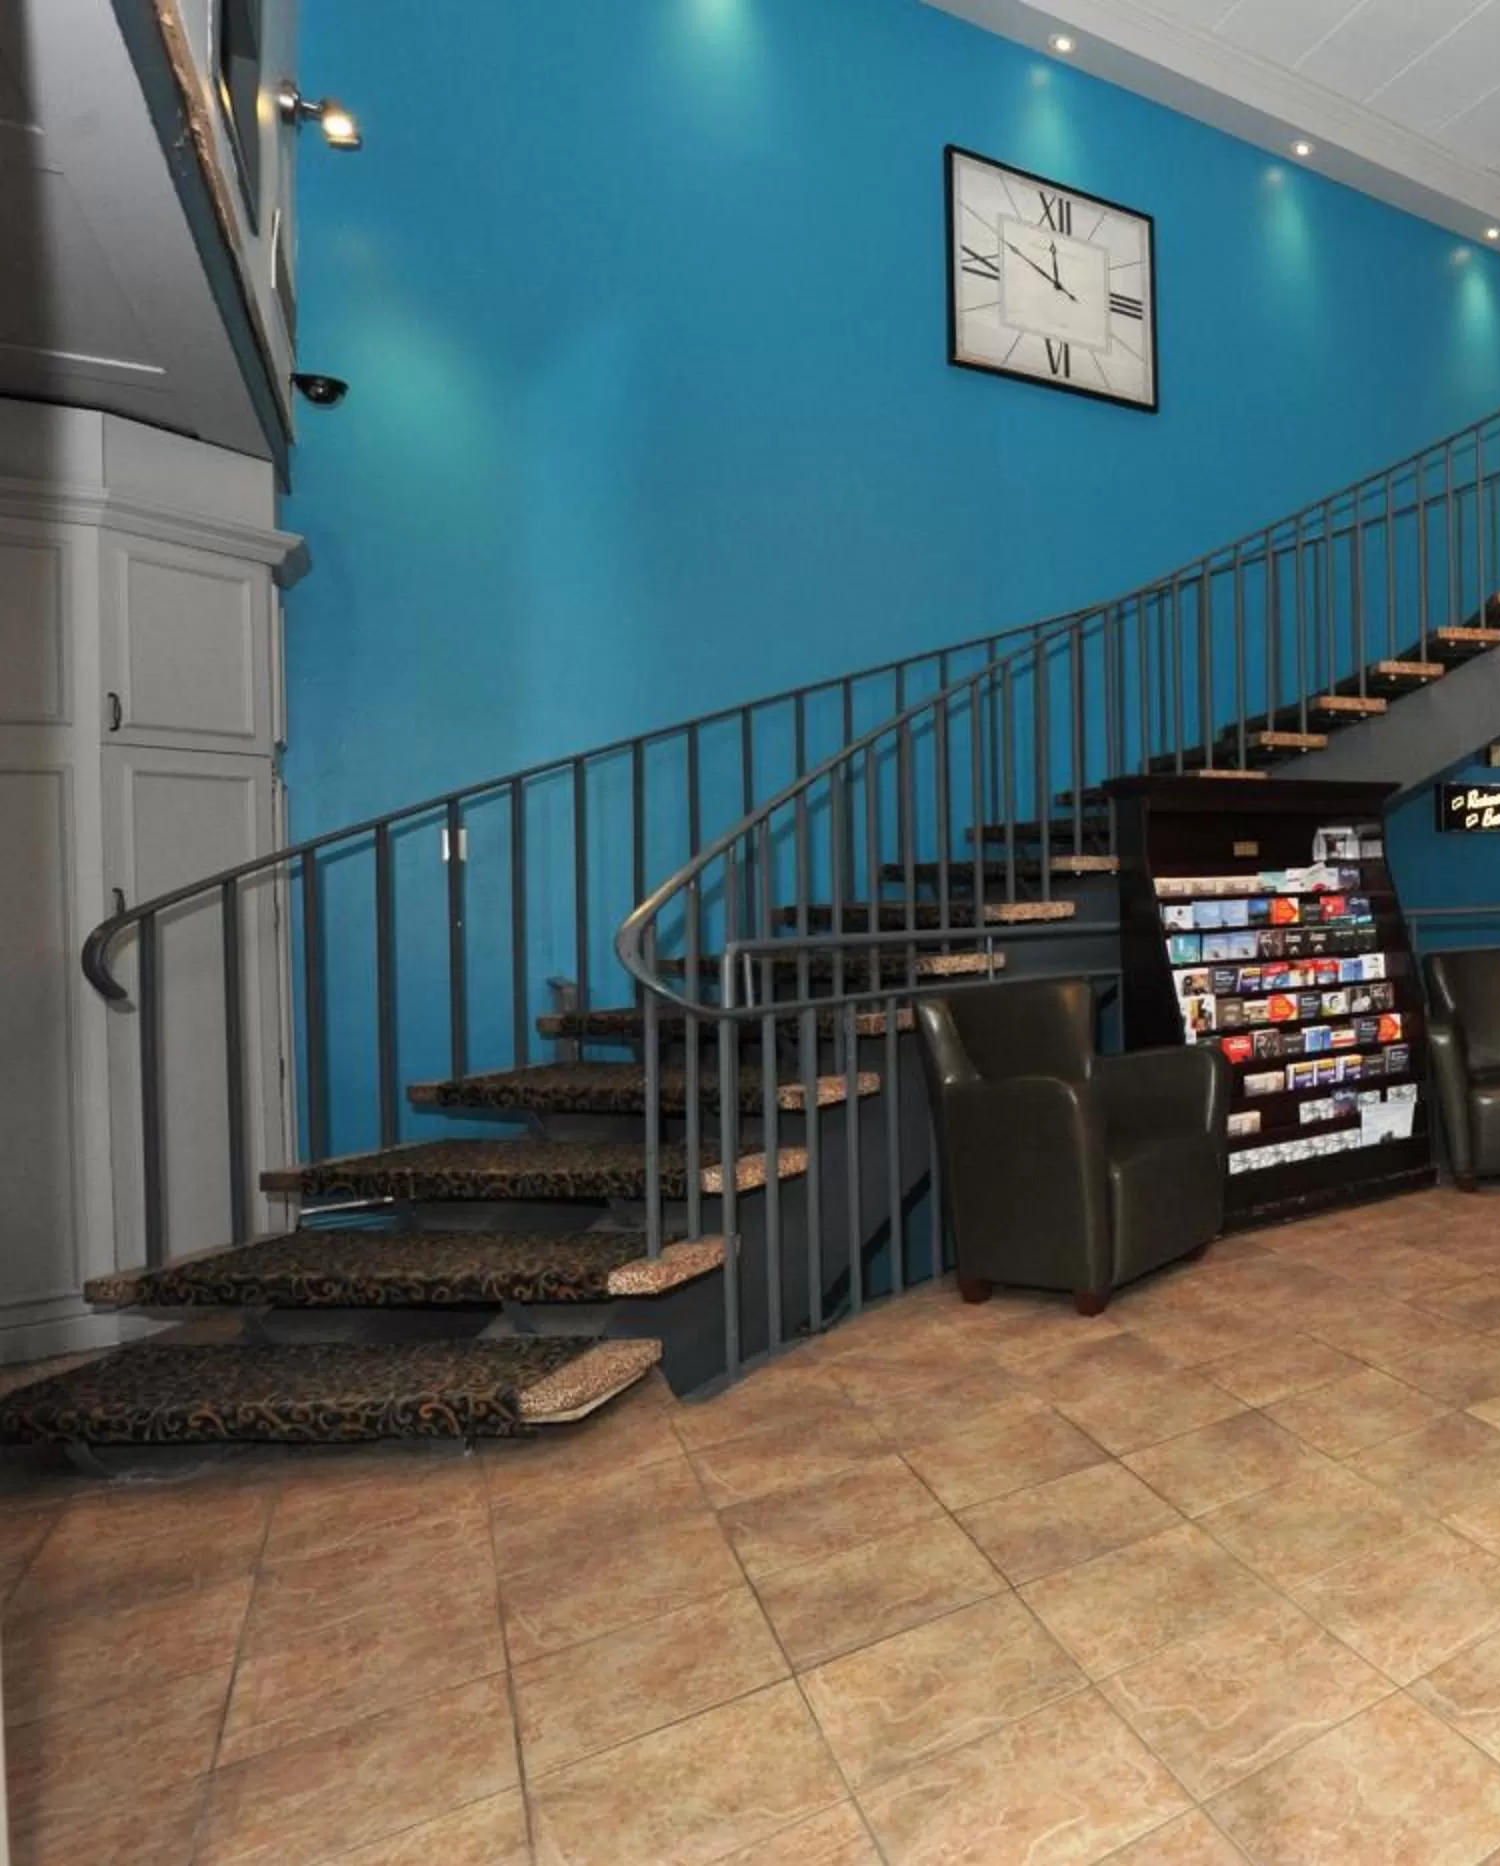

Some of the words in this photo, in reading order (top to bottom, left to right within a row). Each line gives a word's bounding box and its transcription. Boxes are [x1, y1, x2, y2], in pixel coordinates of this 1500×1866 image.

[1038, 191, 1072, 236] XII
[1109, 292, 1143, 320] III
[1045, 338, 1071, 378] VI
